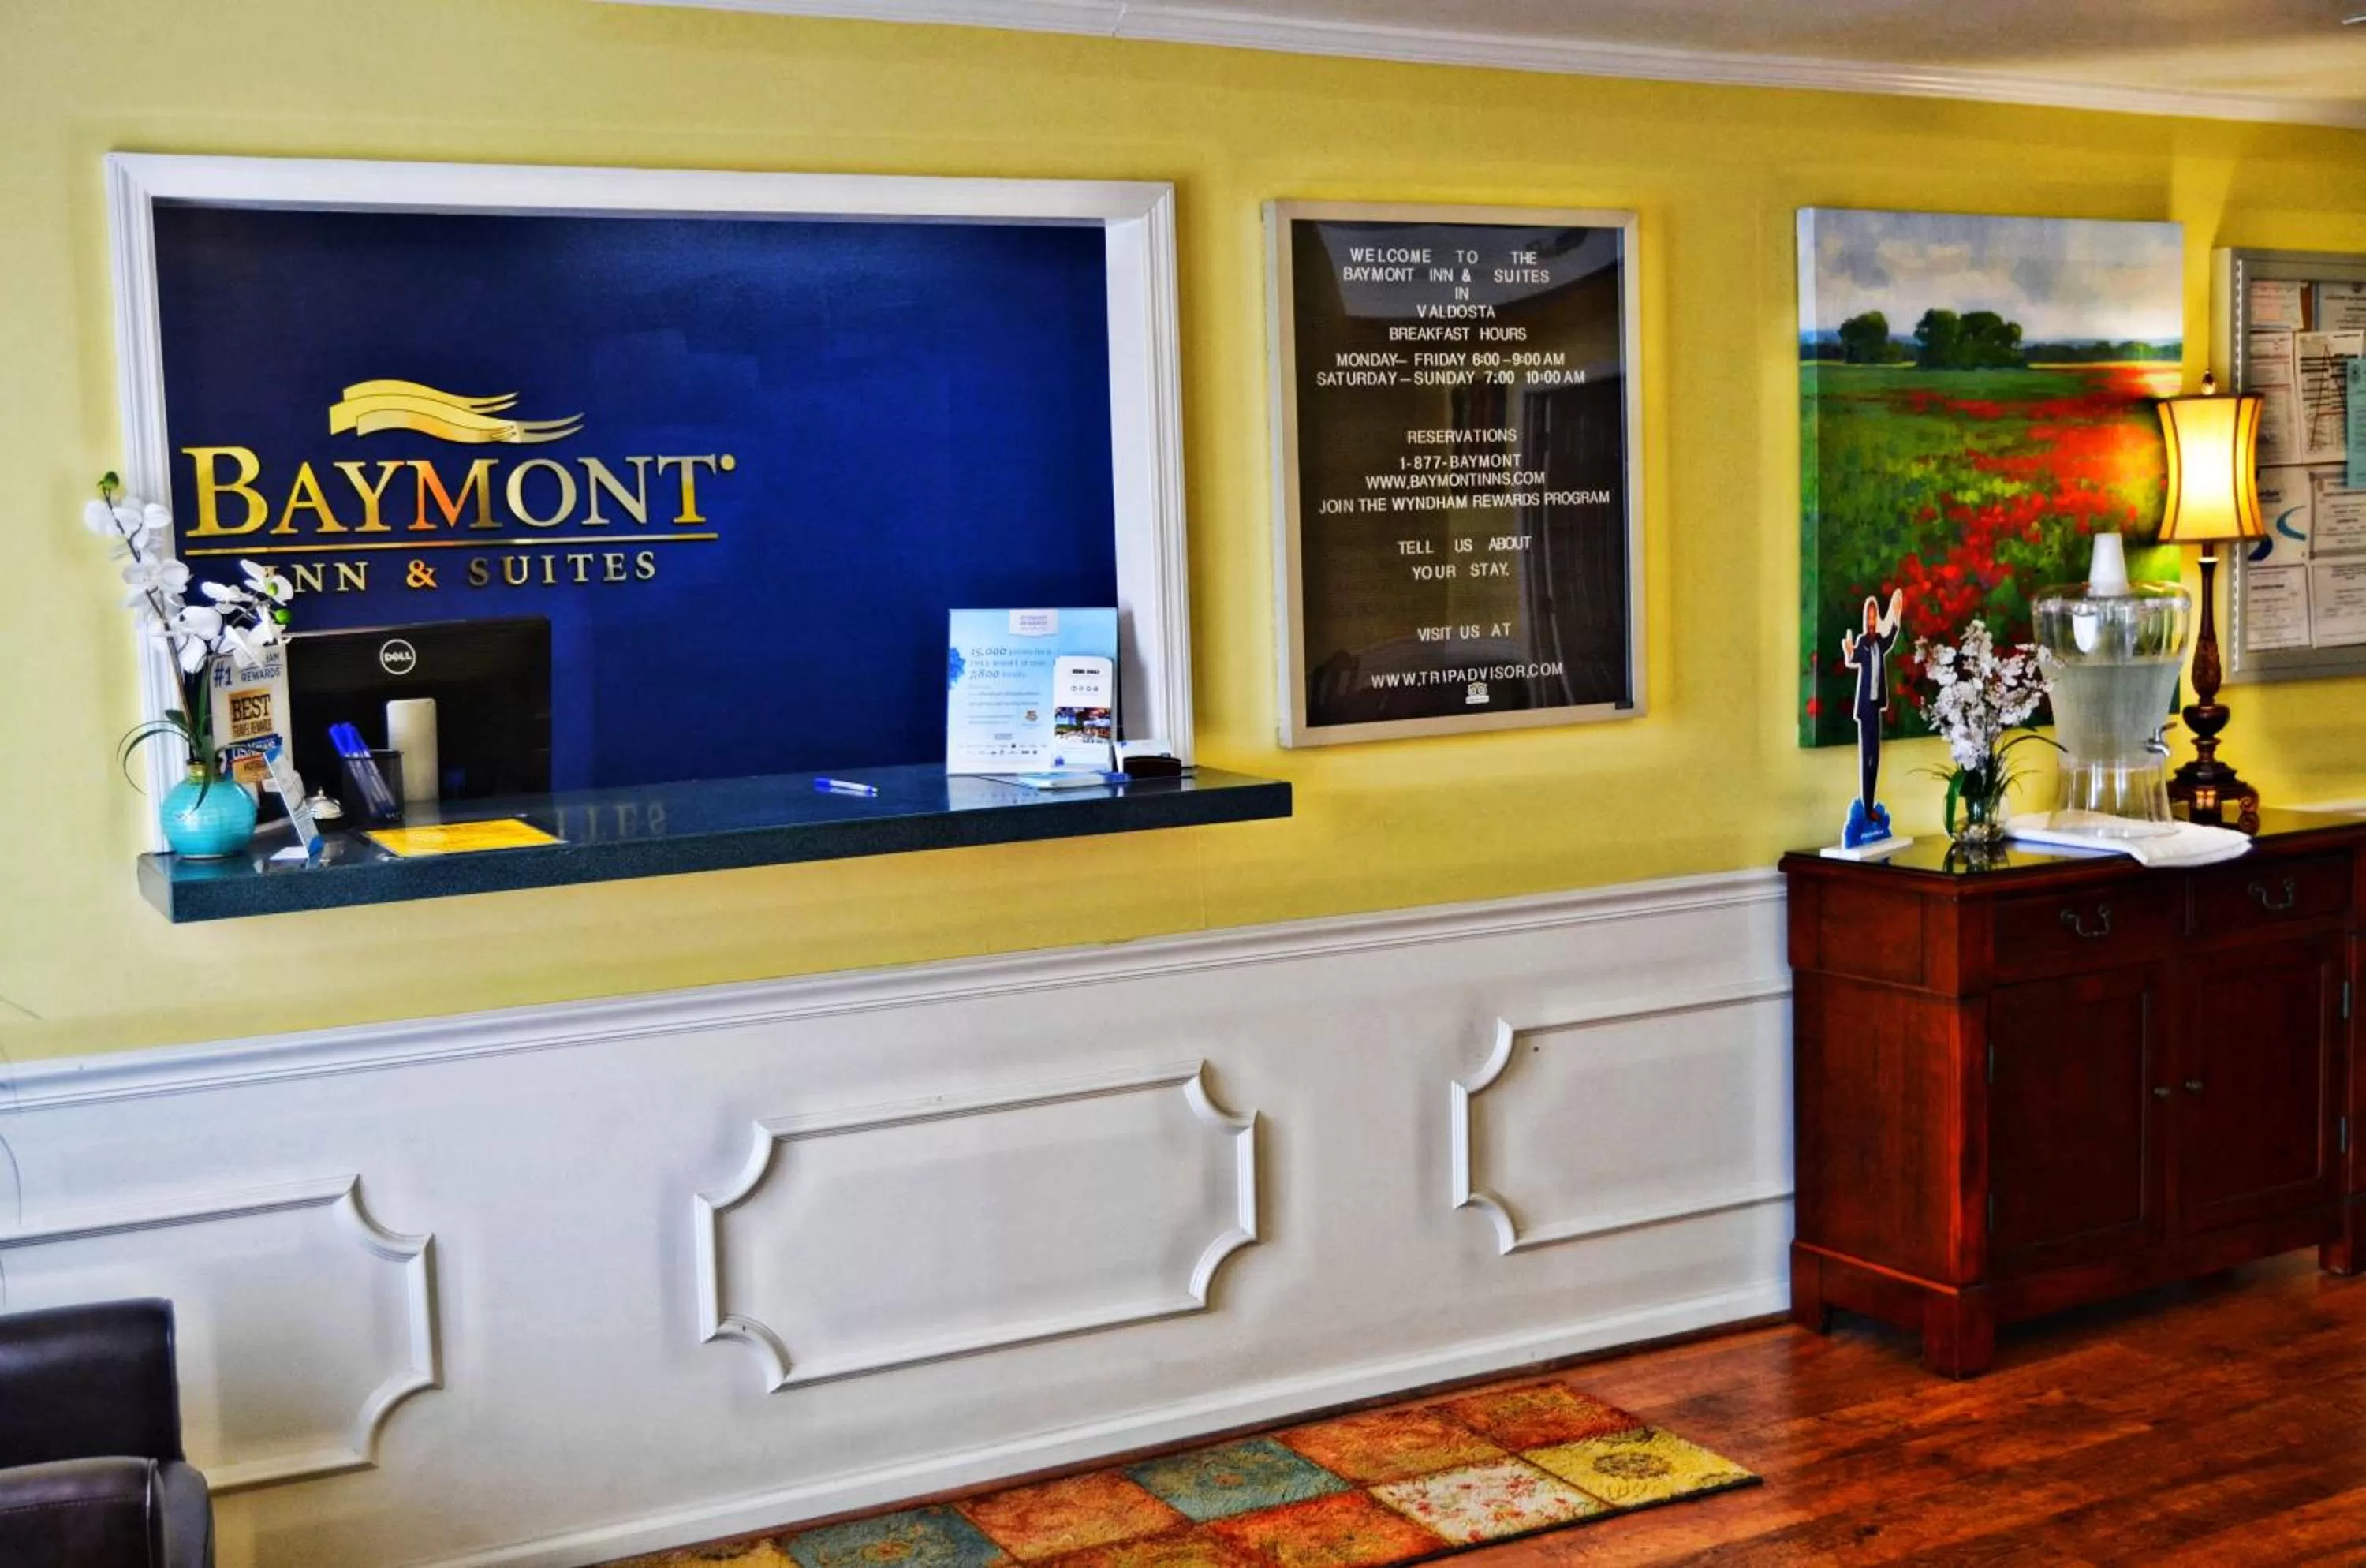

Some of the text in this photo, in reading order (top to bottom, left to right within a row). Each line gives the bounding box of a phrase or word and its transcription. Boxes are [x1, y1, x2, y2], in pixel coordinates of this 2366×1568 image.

[1350, 248, 1536, 264] WELCOME TO THE
[1343, 267, 1549, 282] BAYMONT INN & SUITES
[1455, 287, 1468, 300] IN
[1416, 304, 1495, 318] VALDOSTA
[1390, 327, 1527, 341] BREAKFAST HOURS
[1415, 353, 1465, 366] FRIDAY
[1485, 371, 1514, 384] 7:00
[1407, 428, 1517, 443] RESERVATIONS
[1401, 454, 1521, 470] 1-877-BAYMONT
[1366, 471, 1545, 489] WWW.BAYMONTINNS.COM
[181, 446, 719, 538] BAYMONT
[1319, 491, 1609, 513] JOIN THE WYNDHAM REWARDS PROGRAM
[1398, 536, 1531, 554] TELL US ABOUT
[406, 559, 437, 588] &
[469, 551, 656, 586] SUITES
[1413, 565, 1456, 579] YOUR
[1417, 622, 1511, 640] VISIT US AT
[385, 652, 412, 662] DELL
[214, 661, 233, 688] #1
[1371, 662, 1563, 689] WWW.TRIPADVISOR.COM
[230, 694, 271, 722] BEST
